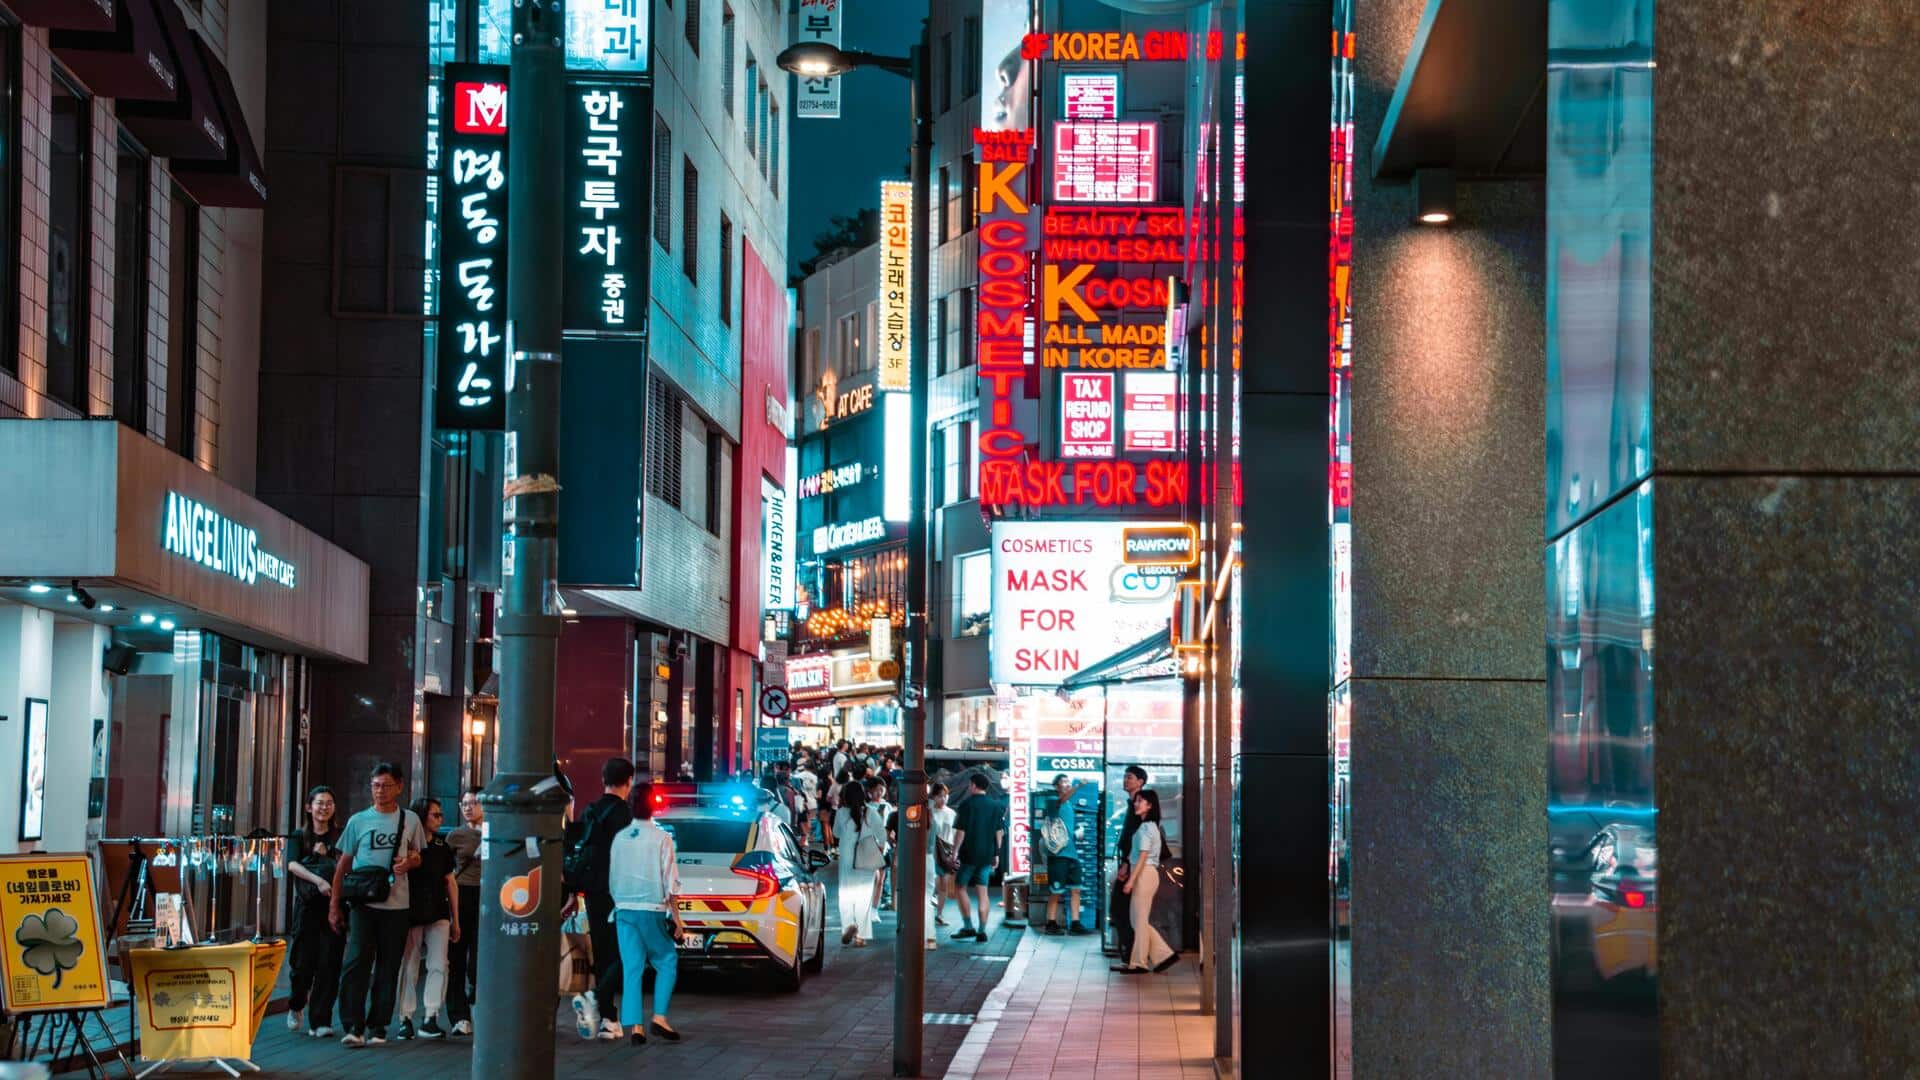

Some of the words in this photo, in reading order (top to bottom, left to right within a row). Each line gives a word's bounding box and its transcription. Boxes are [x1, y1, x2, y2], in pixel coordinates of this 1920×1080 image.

[1053, 32, 1140, 60] KOREA
[973, 128, 1034, 145] WHOLE
[982, 144, 1029, 162] SALE
[579, 90, 624, 267] 한국투자
[979, 162, 1028, 214] K
[1045, 215, 1138, 235] BEAUTY
[601, 273, 626, 325] 증권
[1044, 264, 1099, 322] K
[1044, 325, 1092, 345] ALL
[1102, 325, 1168, 345] MADE
[979, 220, 1027, 474] COSMETIC
[888, 358, 902, 369] 3F
[1043, 348, 1069, 368] IN
[1079, 348, 1167, 369] KOREA
[849, 384, 873, 414] CAFE
[1072, 378, 1102, 399] TAX
[1065, 401, 1111, 419] REFUND
[1071, 421, 1106, 439] SHOP
[979, 462, 1067, 506] MASK
[1075, 462, 1136, 505] FOR
[165, 490, 257, 585] ANGELINUS
[257, 549, 279, 582] BAKERY
[279, 562, 295, 589] CAFE
[1001, 539, 1093, 553] COSMETICS
[1126, 538, 1191, 552] RAWROW
[1007, 569, 1088, 591] MASK
[1020, 609, 1076, 631] FOR
[1014, 649, 1080, 672] SKIN
[1051, 758, 1096, 770] COSRX
[369, 829, 400, 850] Lee
[19, 892, 72, 905] 가져가세요
[498, 921, 540, 937] 서울중구
